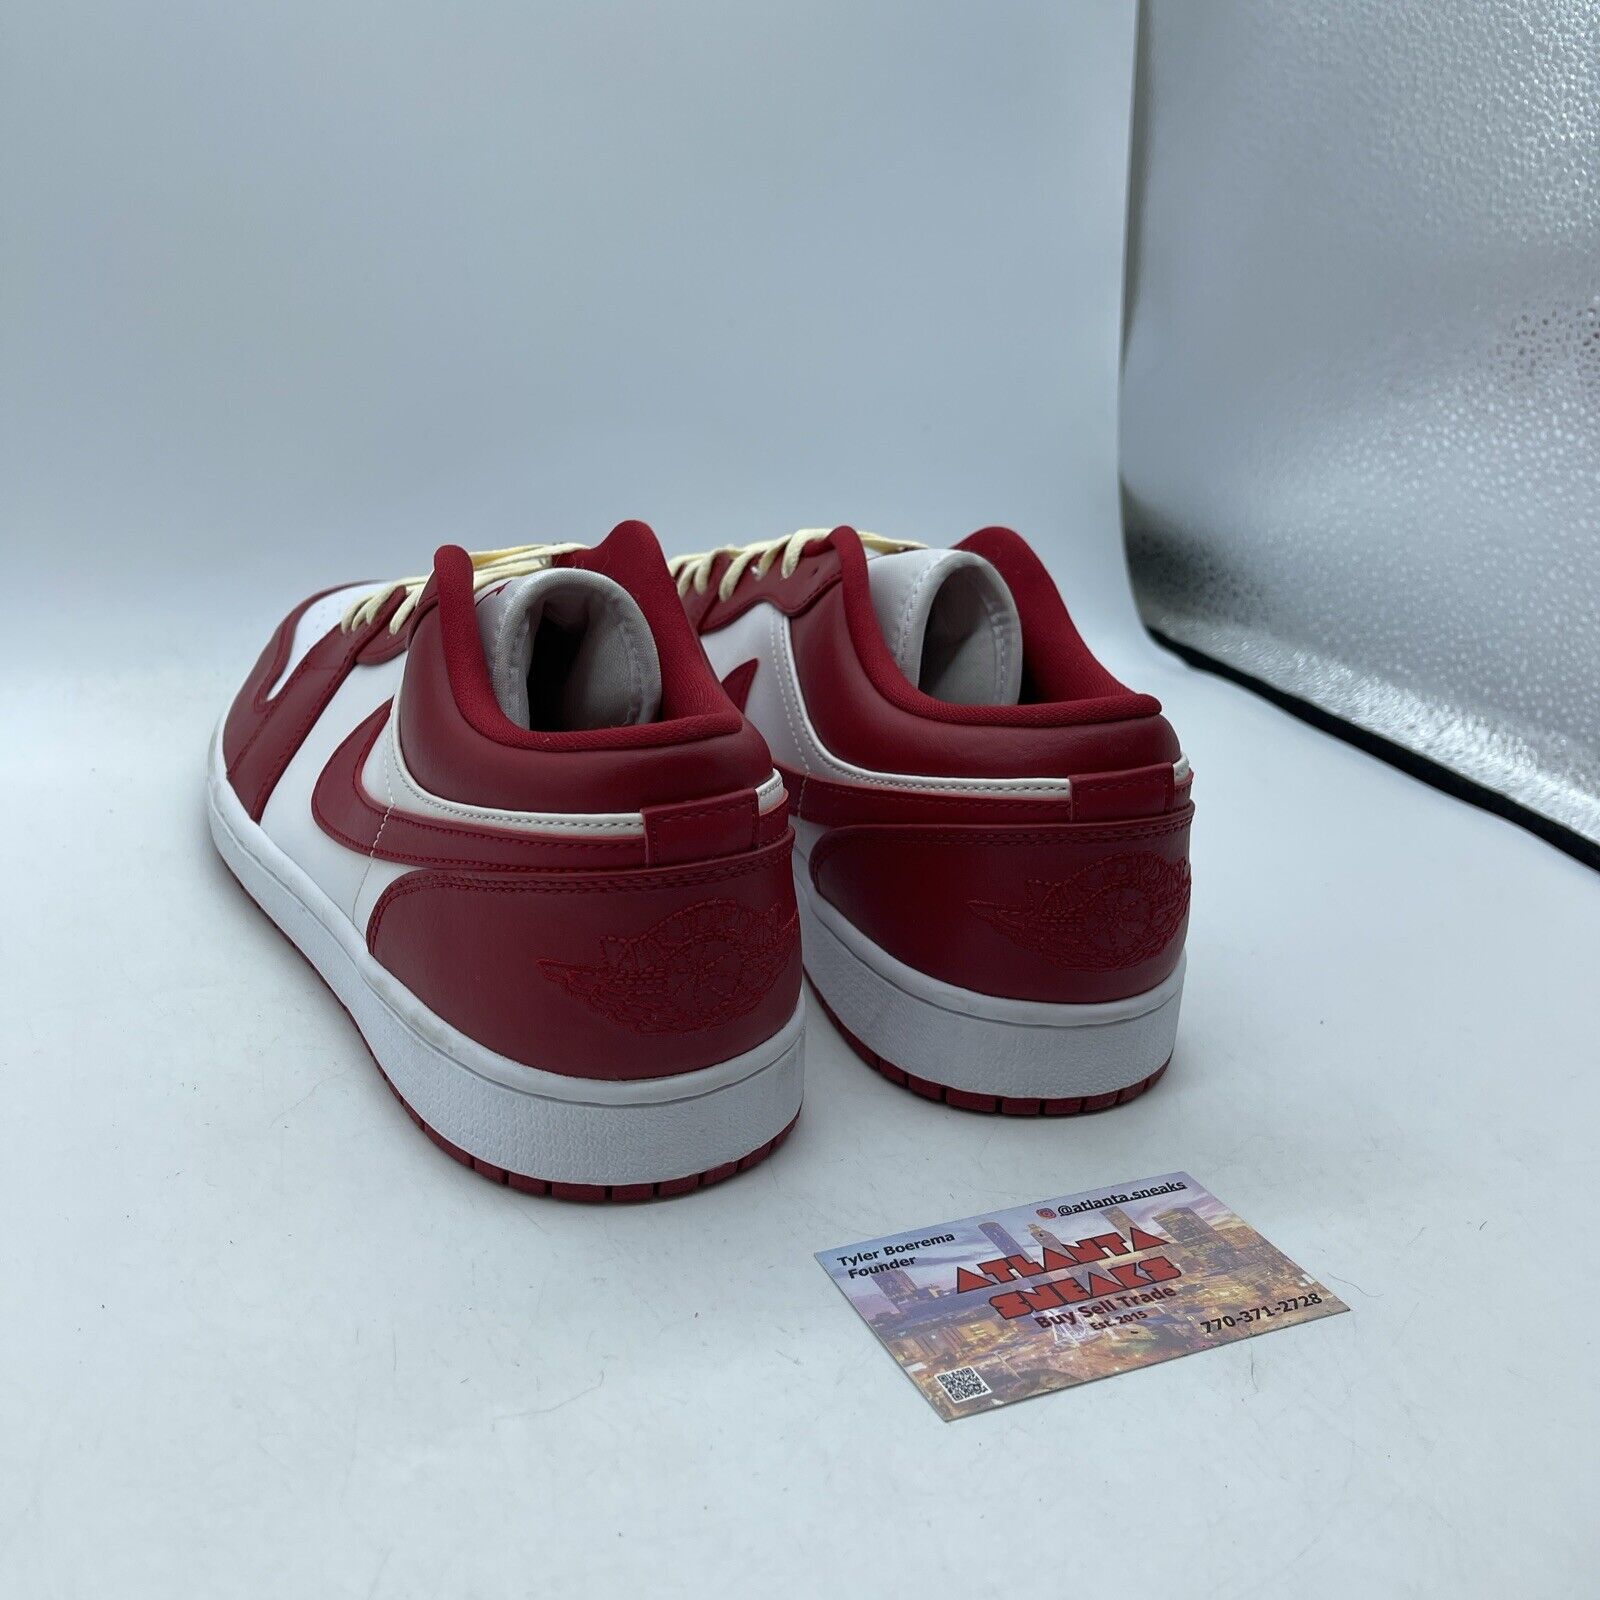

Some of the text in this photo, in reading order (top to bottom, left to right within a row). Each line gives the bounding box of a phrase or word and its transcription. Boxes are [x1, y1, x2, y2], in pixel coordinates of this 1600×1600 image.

[1057, 1181, 1188, 1216] @atlanta.sneaks
[837, 1233, 956, 1267] Tyler Boerema
[848, 1256, 917, 1279] Founder
[956, 1226, 1171, 1295] ATLANTA
[989, 1255, 1183, 1320] SNEAKS
[1034, 1287, 1178, 1329] Buy Sell Trade
[1089, 1310, 1149, 1331] Est. 2015
[1200, 1292, 1323, 1334] 770-371-2728
